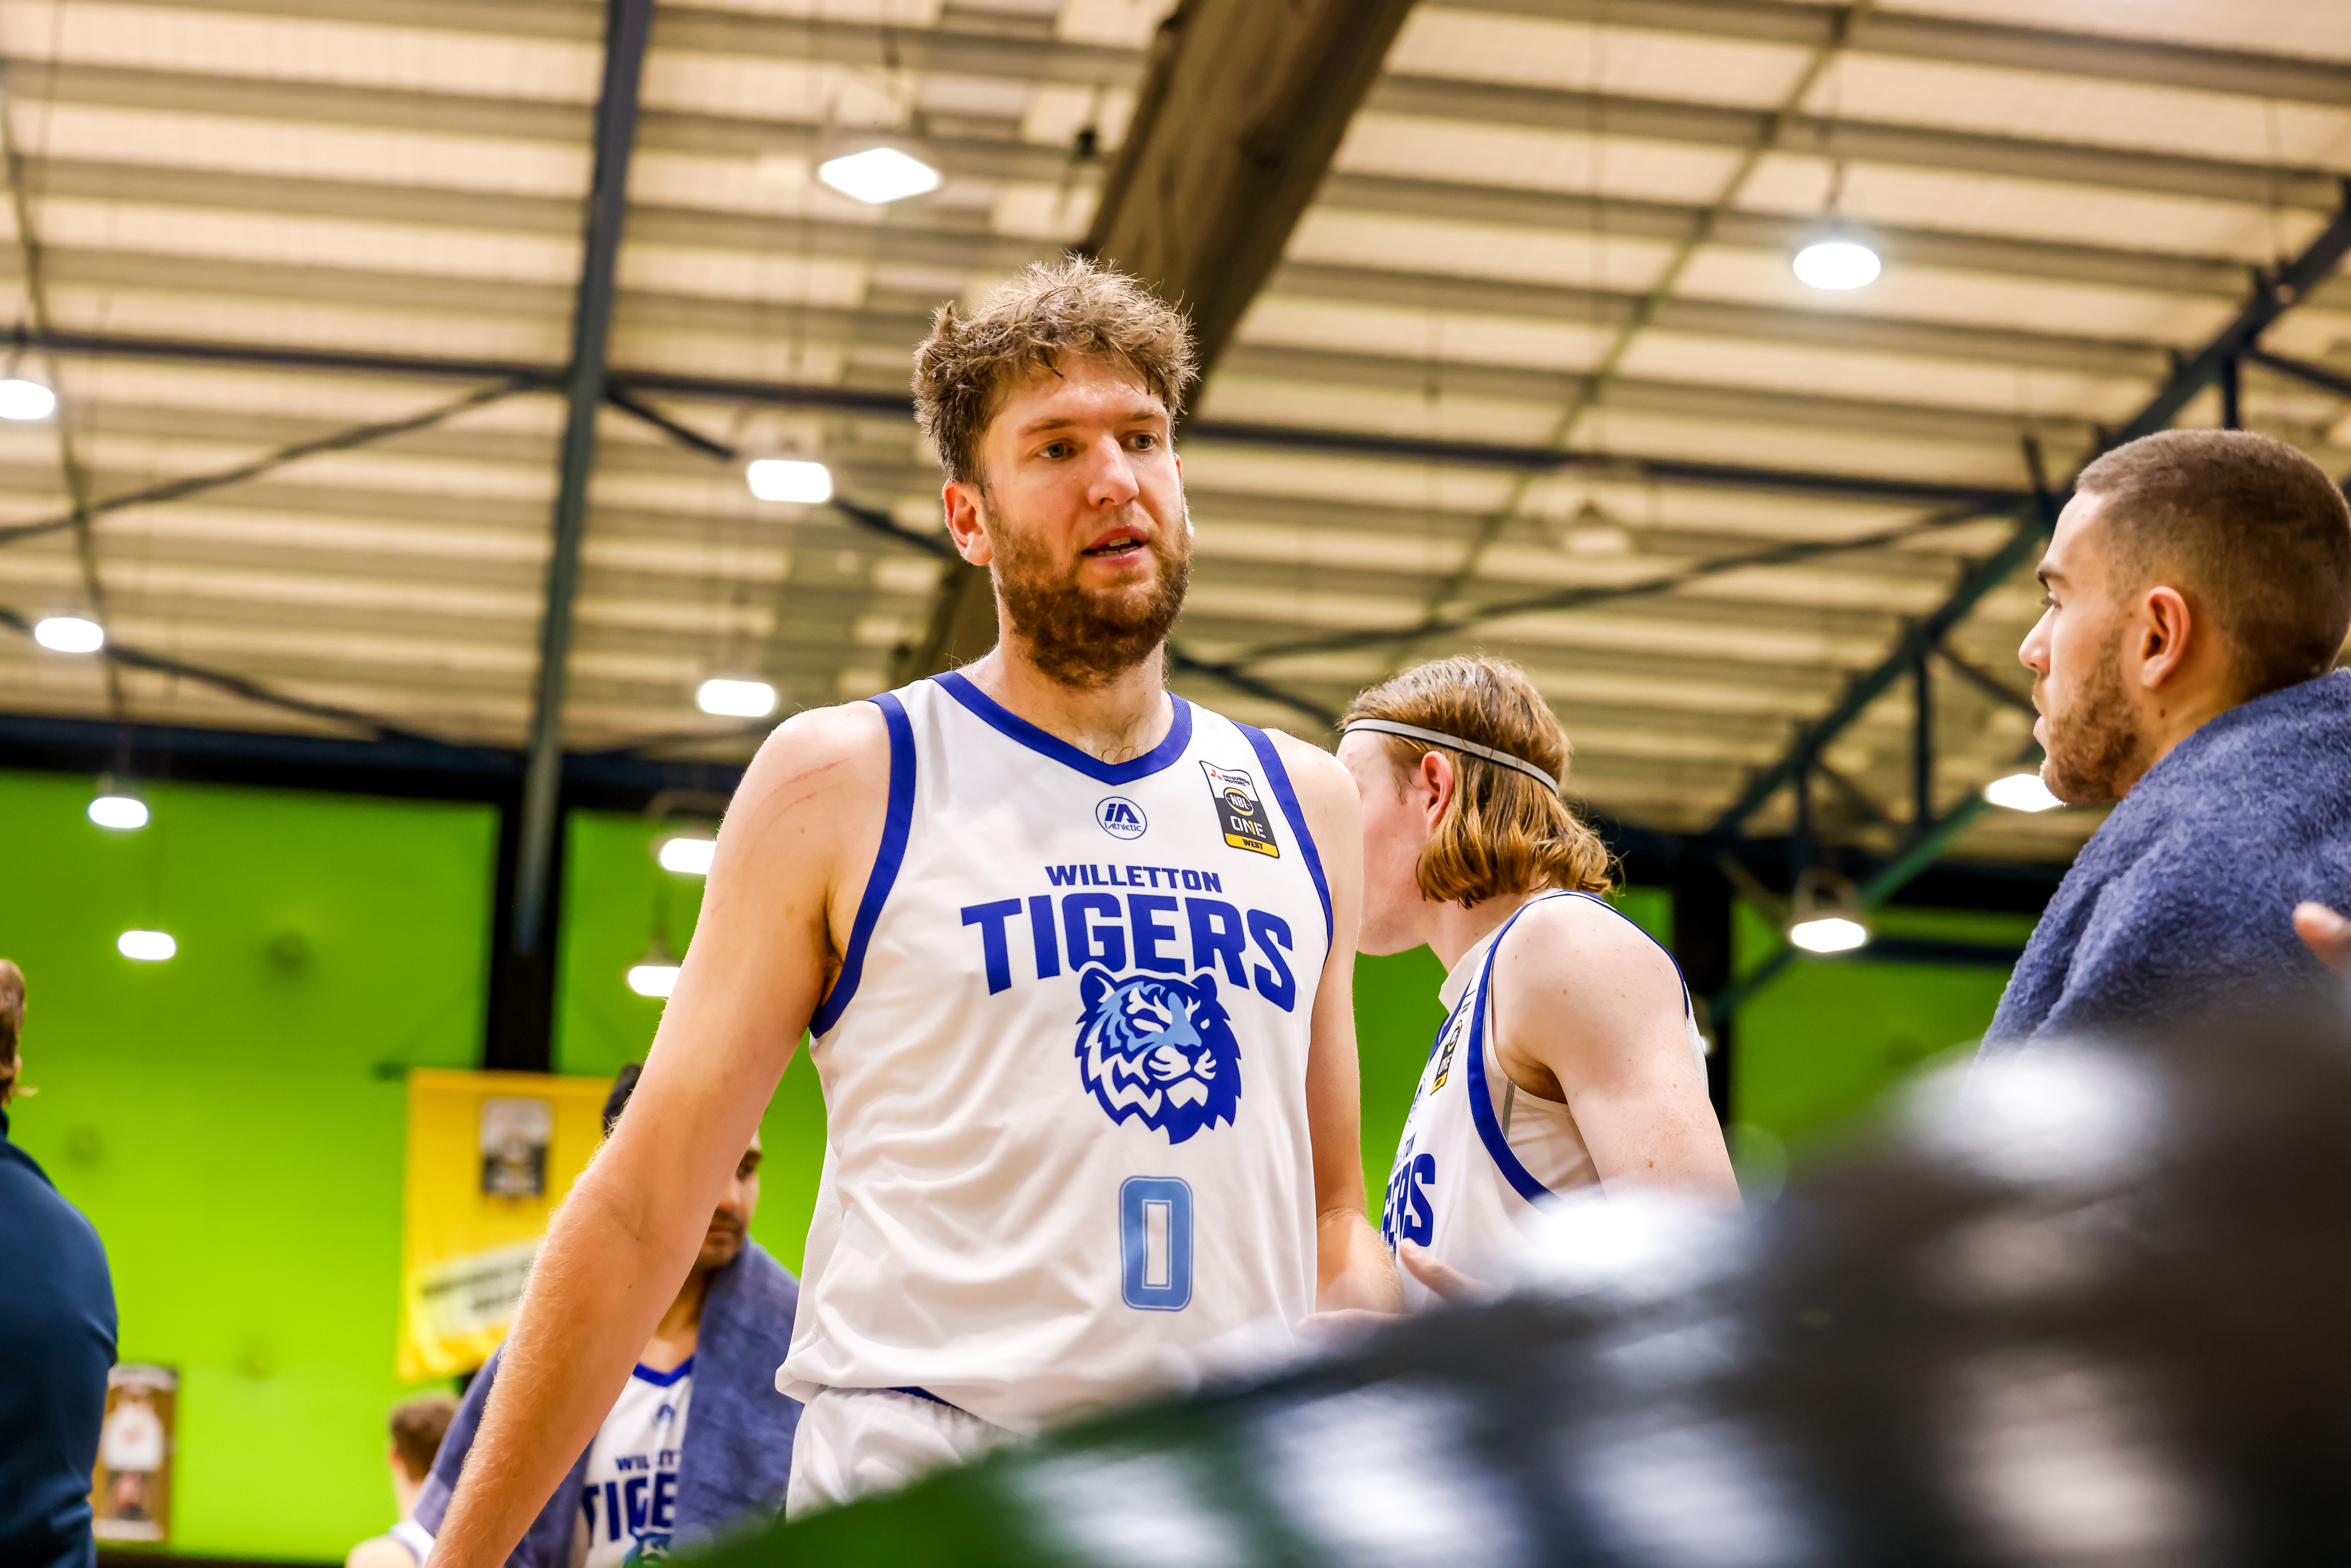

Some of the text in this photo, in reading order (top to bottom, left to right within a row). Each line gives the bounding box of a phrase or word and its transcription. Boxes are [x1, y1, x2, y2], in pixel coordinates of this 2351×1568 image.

[1224, 778, 1245, 787] MOTORS
[1230, 794, 1250, 810] NBL
[1230, 815, 1267, 839] ONE
[1243, 838, 1264, 850] WEST
[1045, 864, 1223, 893] WILLETTON
[960, 893, 1296, 1013] TIGERS
[1119, 1175, 1194, 1312] 0
